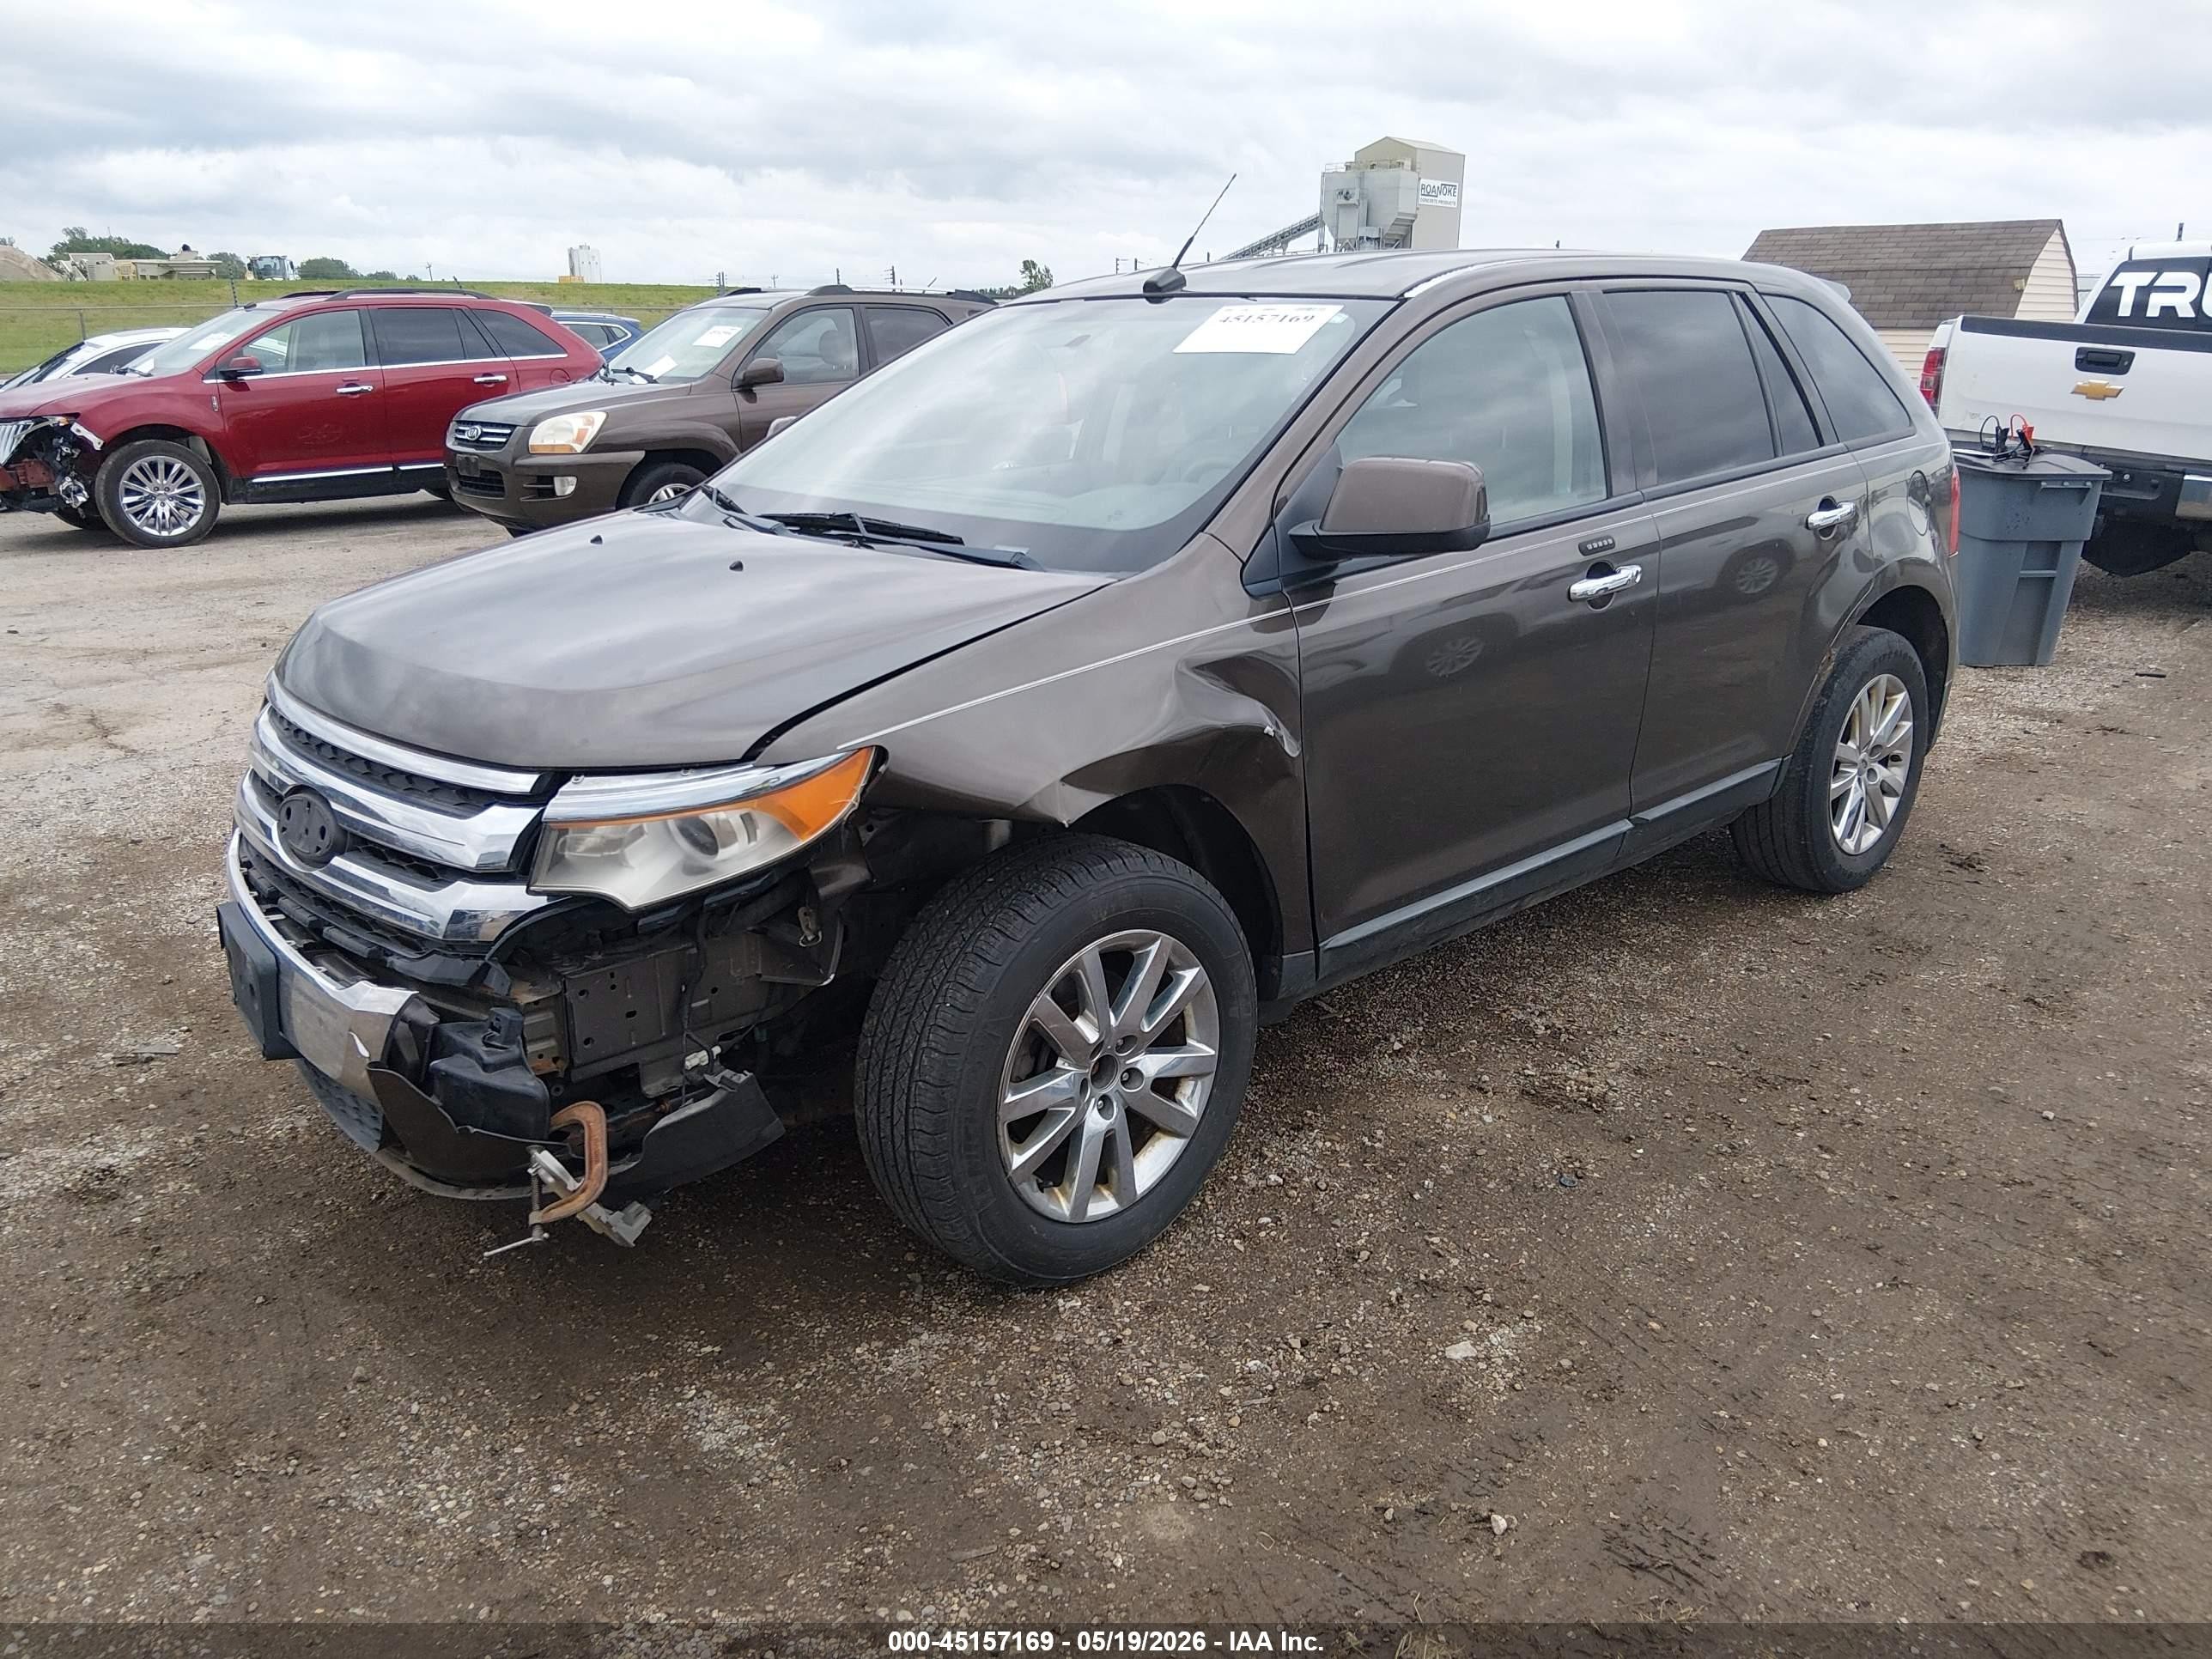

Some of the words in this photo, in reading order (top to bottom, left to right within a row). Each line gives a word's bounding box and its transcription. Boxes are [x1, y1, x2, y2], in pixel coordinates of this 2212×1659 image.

[1420, 183, 1457, 198] ROANOKE
[2110, 271, 2212, 318] TR
[1218, 314, 1316, 324] 45157169
